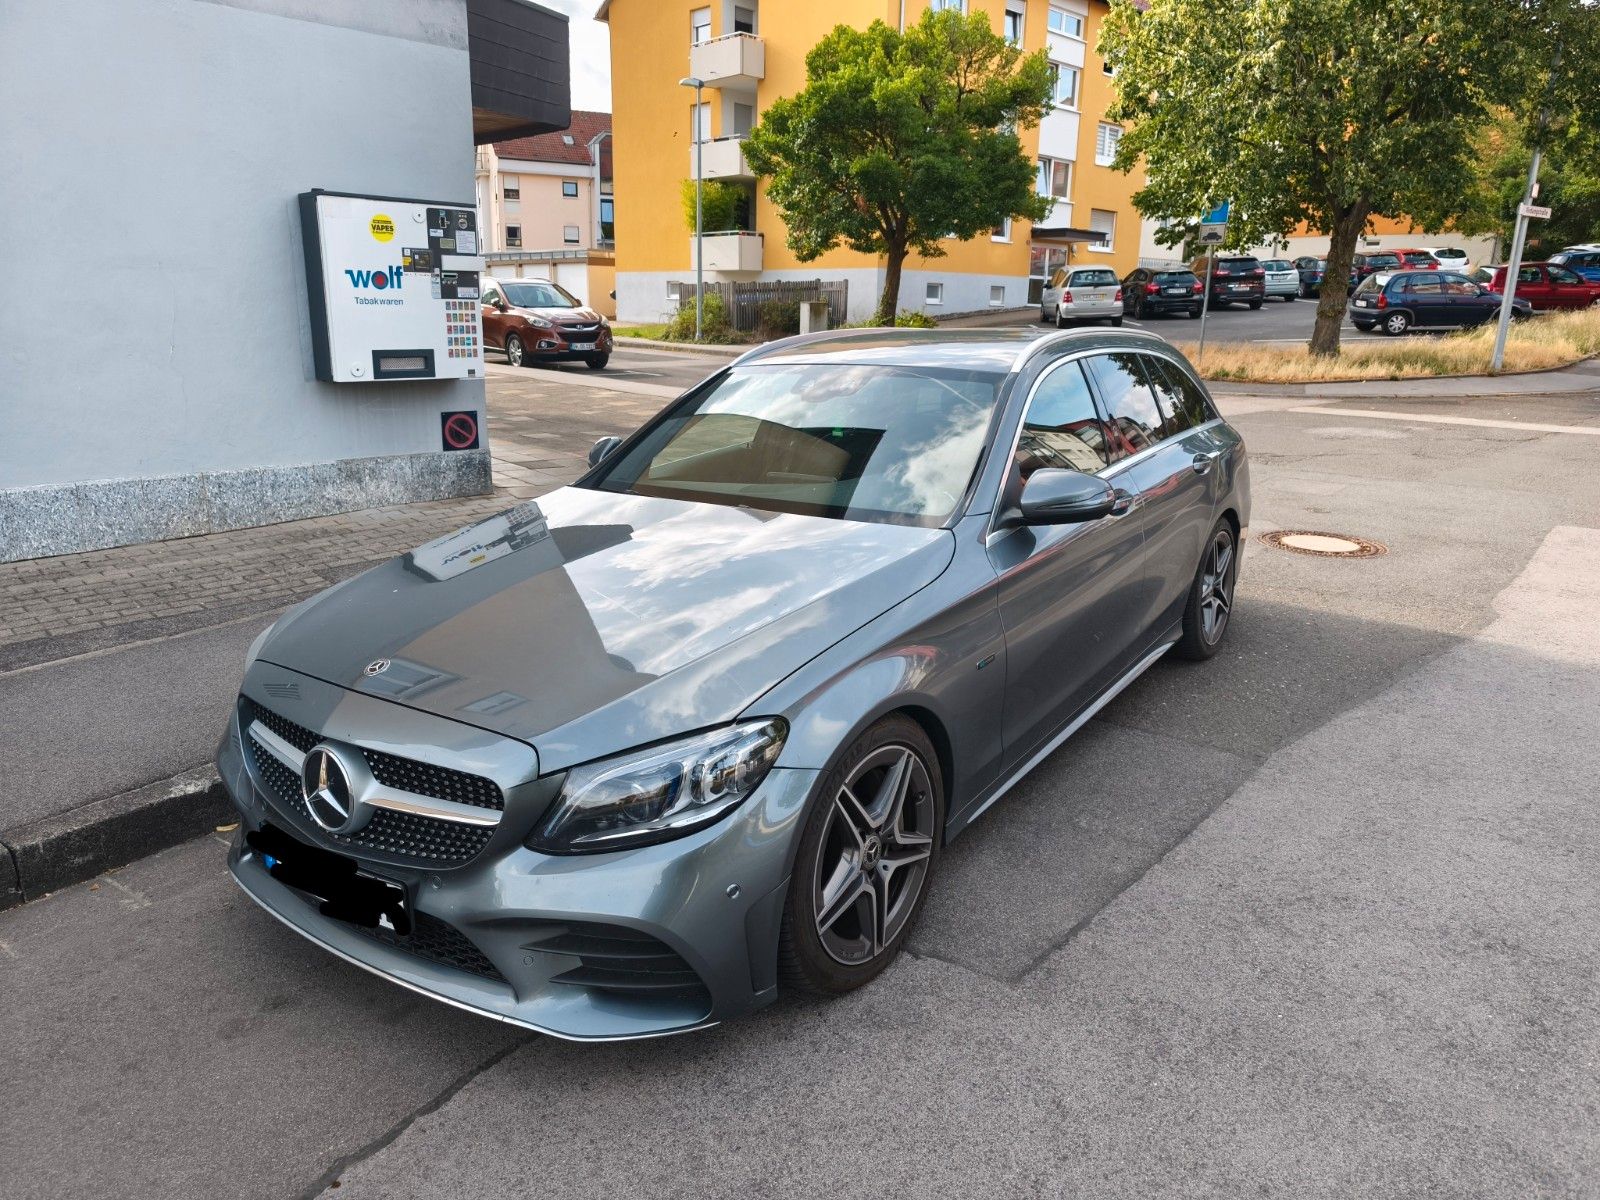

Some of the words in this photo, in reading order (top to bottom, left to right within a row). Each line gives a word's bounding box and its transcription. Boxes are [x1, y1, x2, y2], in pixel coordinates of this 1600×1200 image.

[371, 224, 394, 232] VAPES
[345, 265, 403, 290] wolf
[354, 296, 404, 305] Tabakwaren
